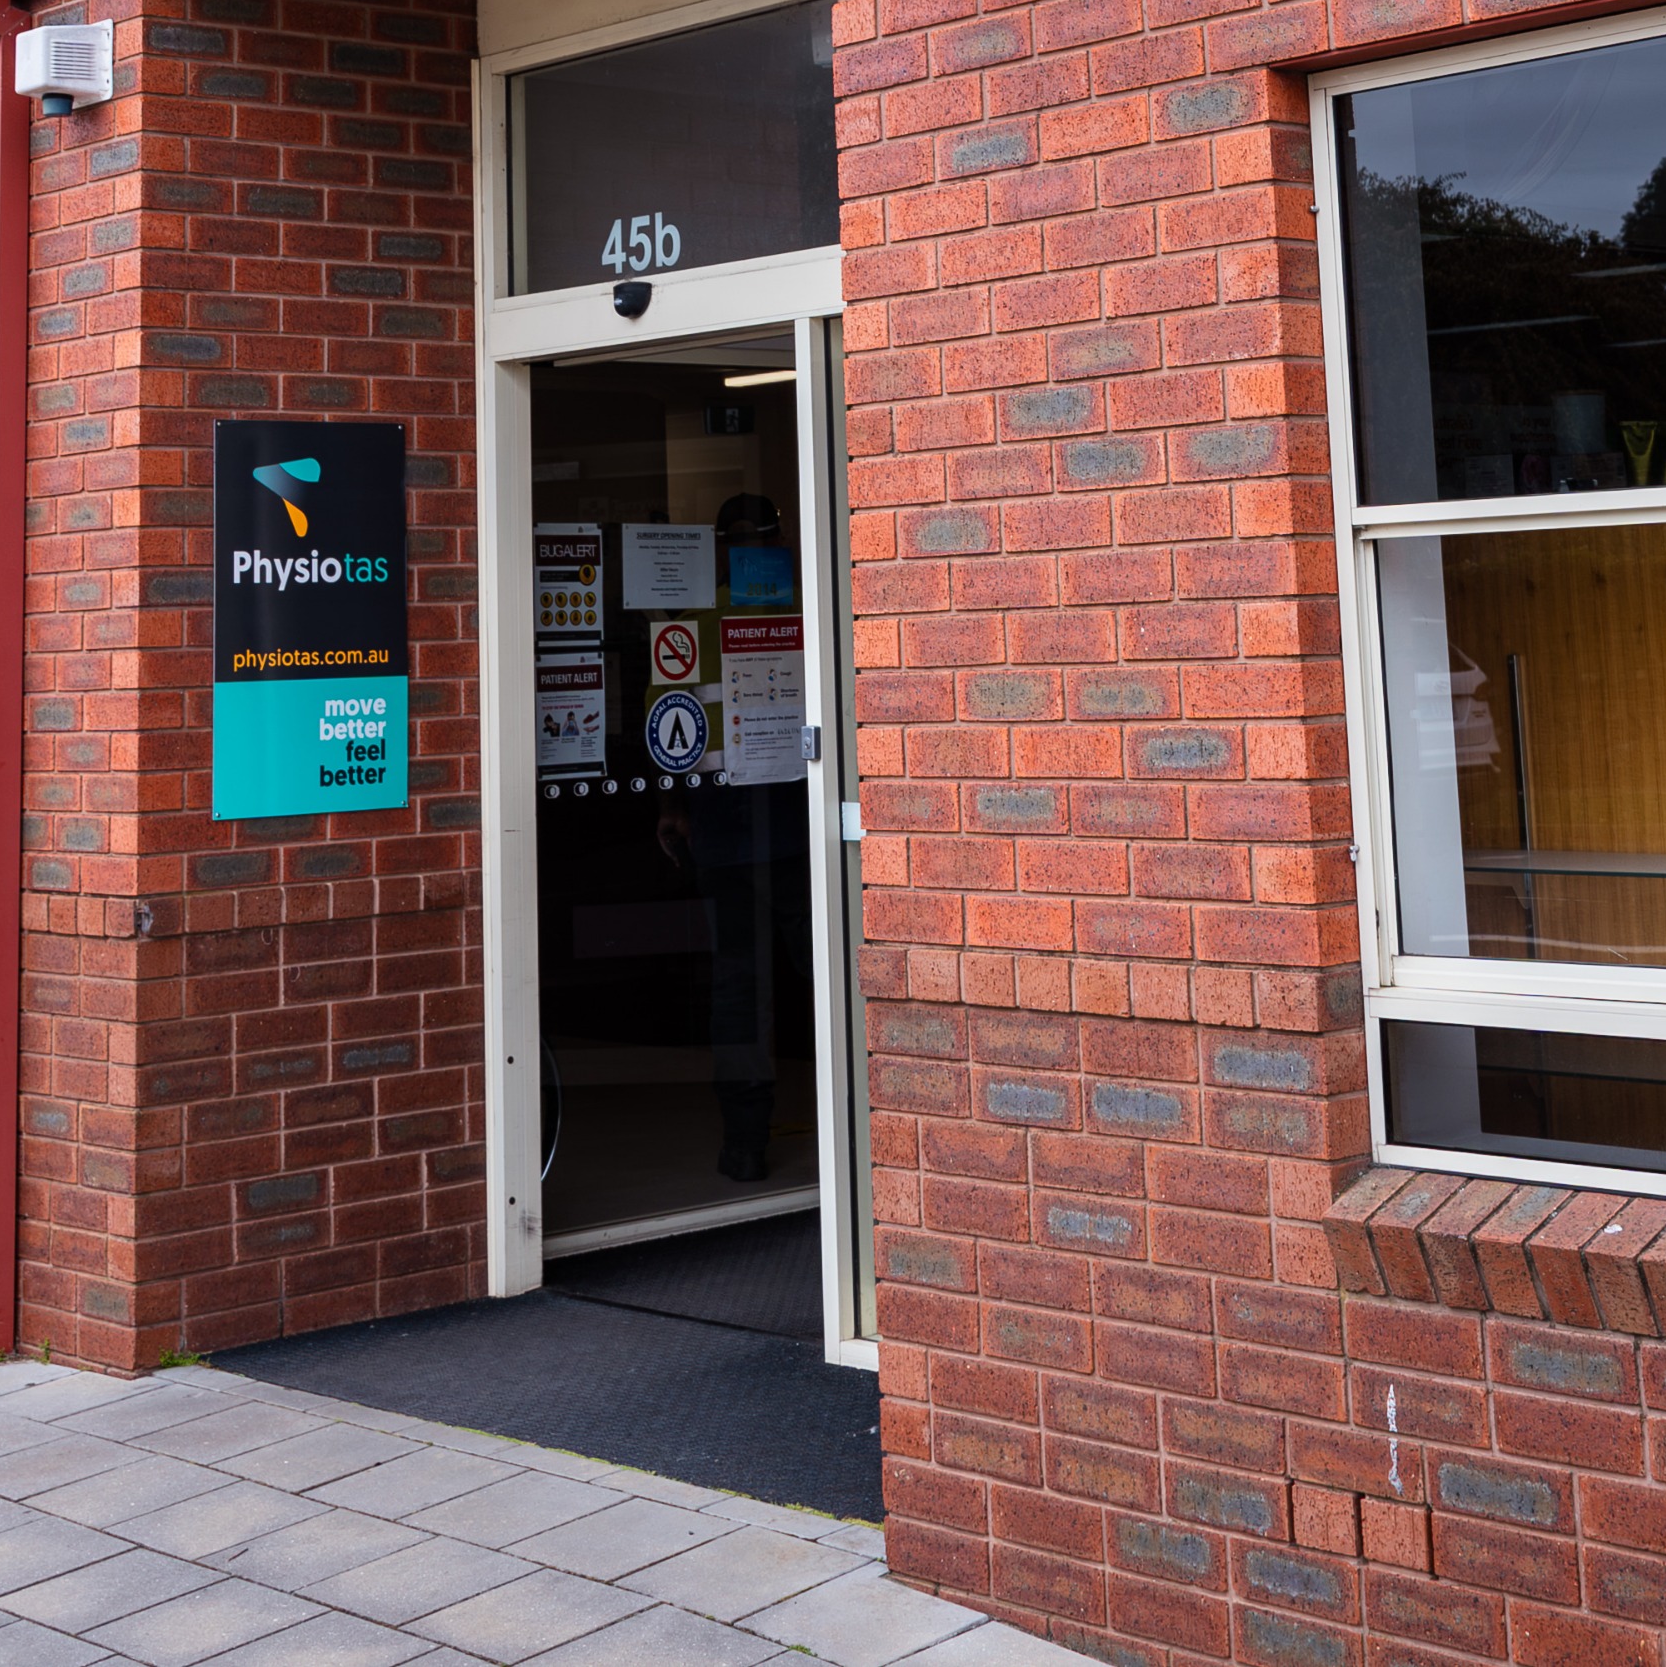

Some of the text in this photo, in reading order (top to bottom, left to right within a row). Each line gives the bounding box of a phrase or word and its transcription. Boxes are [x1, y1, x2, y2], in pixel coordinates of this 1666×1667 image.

[601, 212, 682, 274] 45b
[233, 549, 389, 591] Physiotas
[747, 582, 777, 596] 2014
[728, 626, 799, 639] PATIENT ALERT
[233, 648, 389, 672] physiotas.com.au
[541, 672, 598, 685] PATIENT ALERT
[325, 697, 386, 716] move
[651, 696, 703, 729] AGPAL ACCREDITED
[319, 718, 386, 741] better
[346, 739, 386, 762] feel
[653, 742, 703, 767] GENERAL PRACTICE
[319, 765, 386, 788] better
